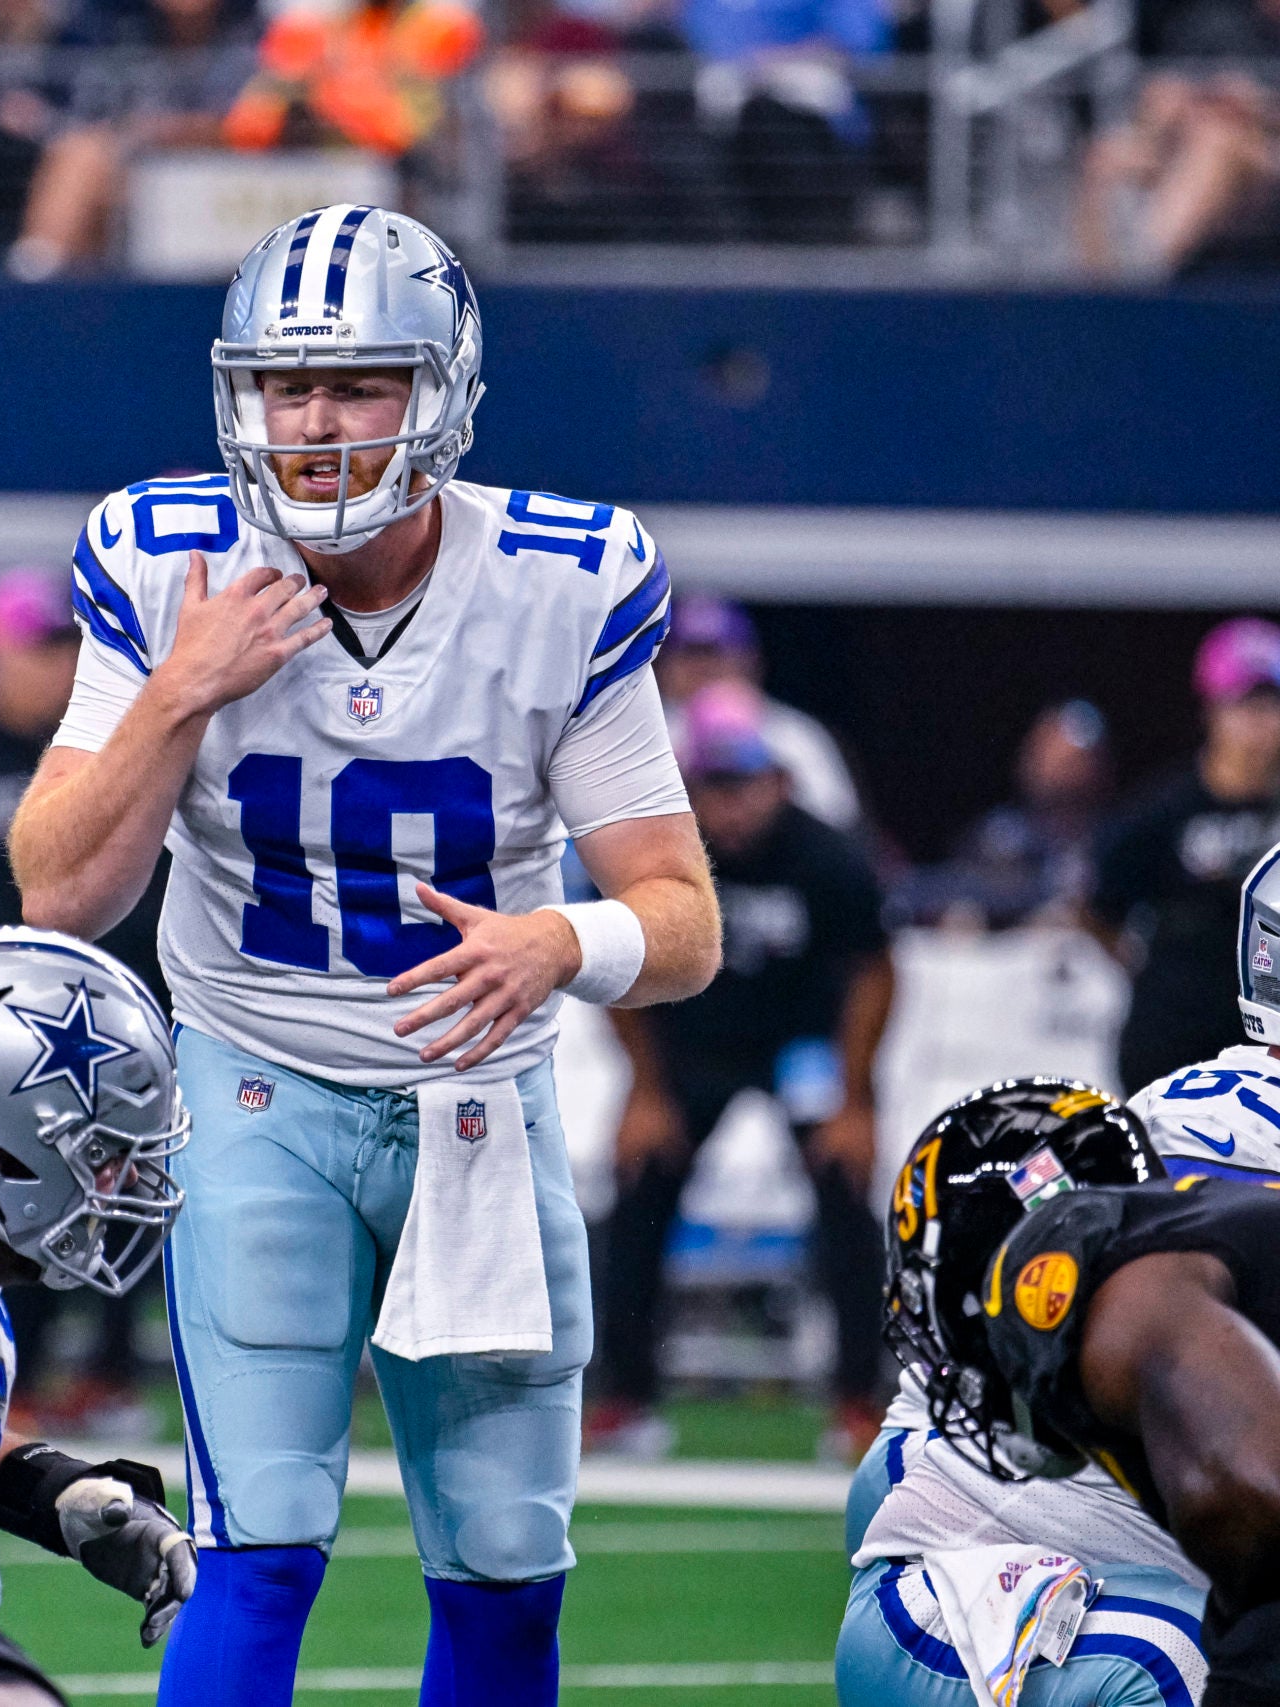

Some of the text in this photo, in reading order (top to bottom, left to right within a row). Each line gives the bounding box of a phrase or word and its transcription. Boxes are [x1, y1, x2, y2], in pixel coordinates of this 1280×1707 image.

[282, 326, 333, 336] COWBOYS
[497, 490, 616, 576] 10
[352, 699, 376, 716] NFL
[227, 753, 497, 978] 10
[1253, 956, 1272, 968] CATCH
[241, 1090, 266, 1106] NFL
[460, 1118, 484, 1138] NFL
[893, 1138, 942, 1242] 97
